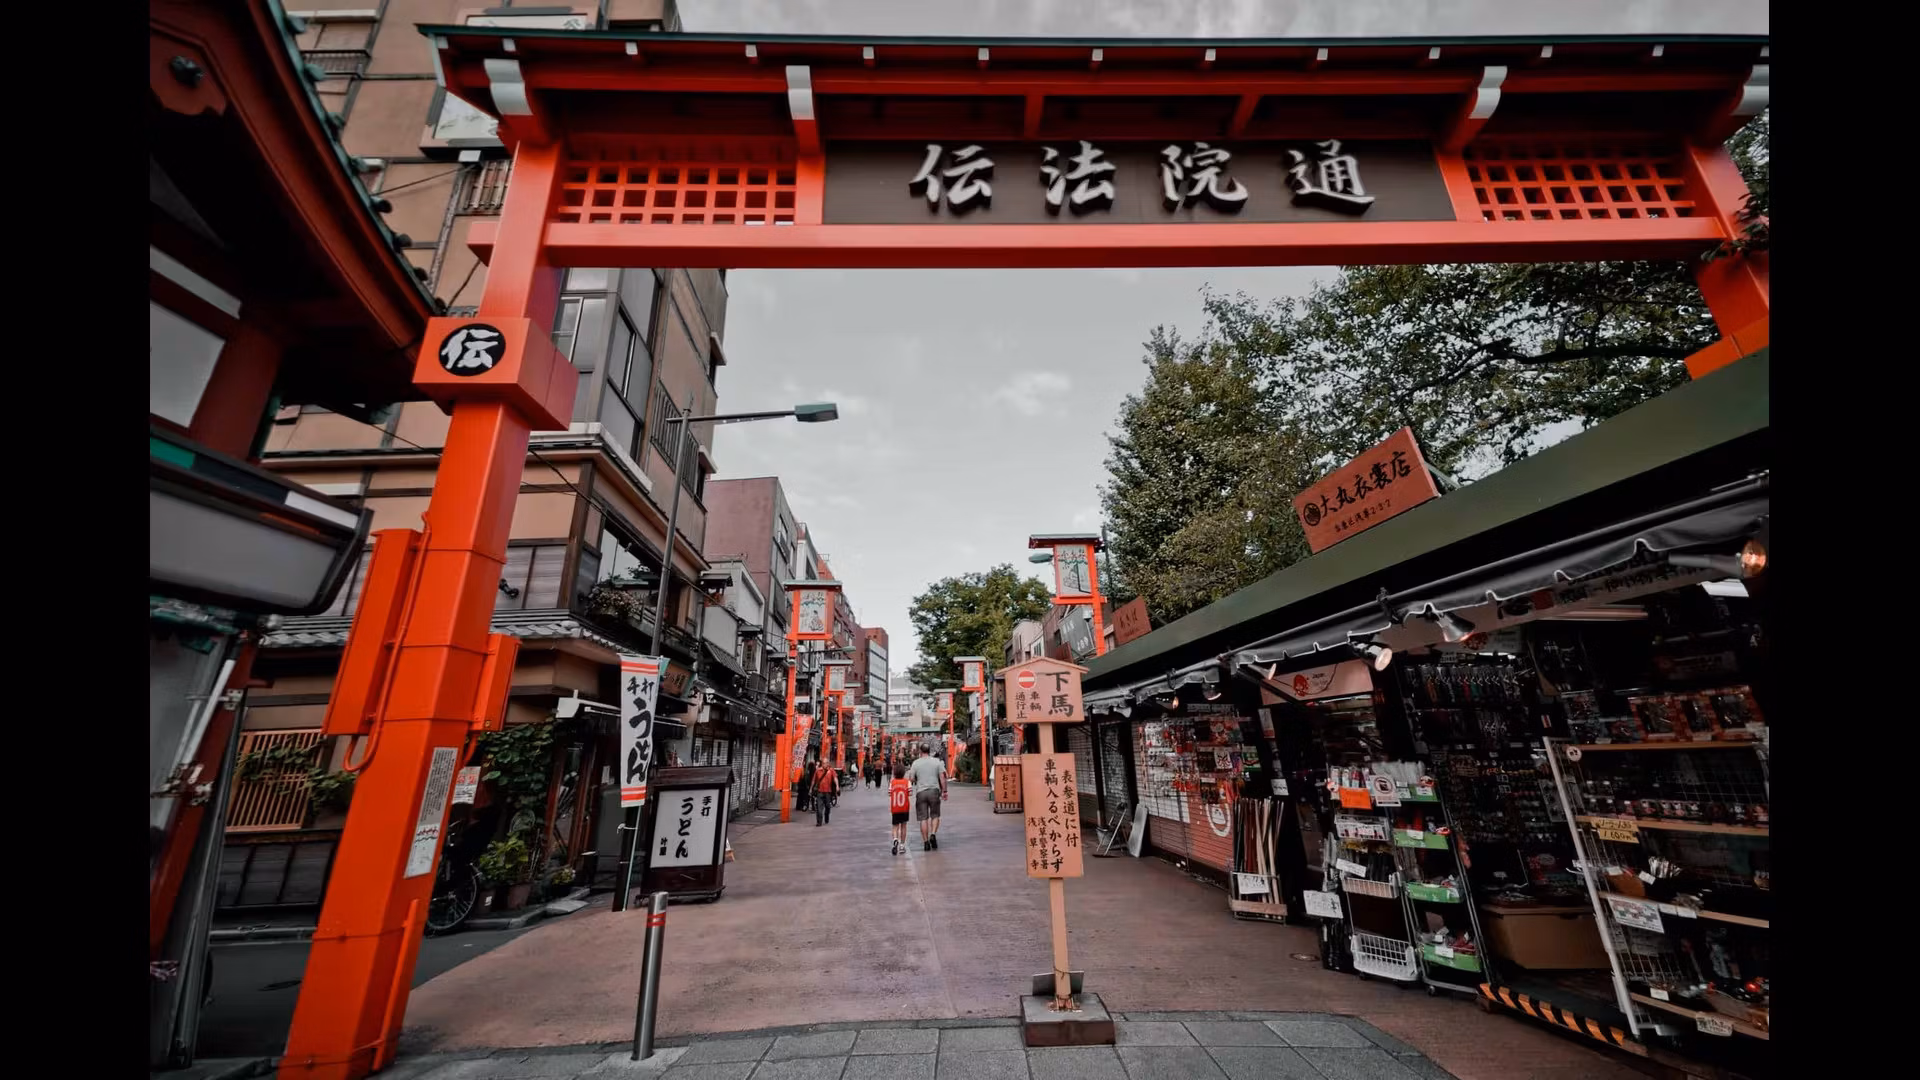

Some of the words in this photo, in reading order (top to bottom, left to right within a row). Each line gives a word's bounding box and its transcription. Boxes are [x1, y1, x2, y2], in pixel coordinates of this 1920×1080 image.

[909, 140, 1375, 213] 伝法院通
[441, 329, 499, 370] 伝
[1320, 451, 1411, 518] 大丸衣裳店
[626, 676, 655, 696] 手打
[1016, 691, 1028, 719] 通行止
[1046, 671, 1074, 718] 下馬
[626, 697, 652, 785] うどん
[701, 795, 712, 817] 手打
[893, 790, 906, 807] 10
[1061, 770, 1079, 848] 表参道に付
[675, 796, 694, 858] うどん
[1028, 817, 1039, 870] 浅草寺
